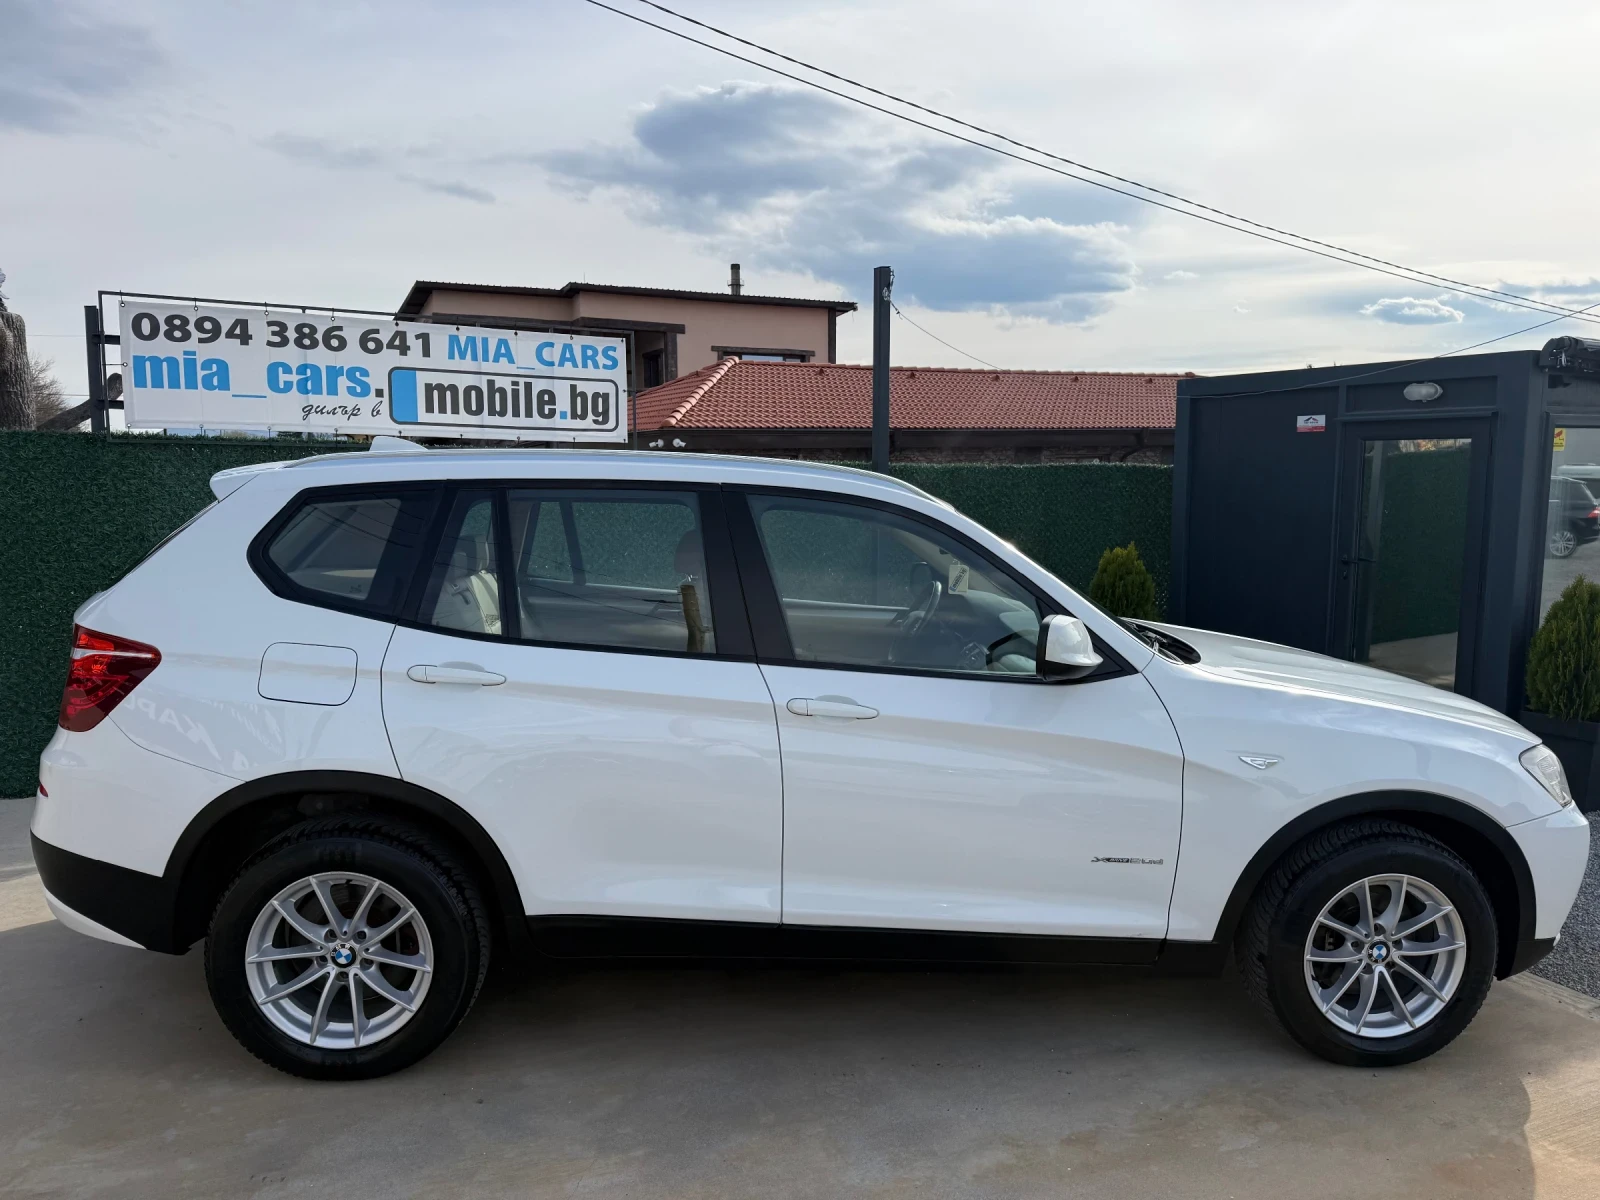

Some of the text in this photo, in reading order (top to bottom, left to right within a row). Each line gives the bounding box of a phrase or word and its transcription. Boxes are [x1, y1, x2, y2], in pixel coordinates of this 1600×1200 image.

[131, 312, 619, 371] 0894 386 641 MIA_CARS
[302, 404, 362, 421] дилър
[424, 379, 610, 426] mobile.bg
